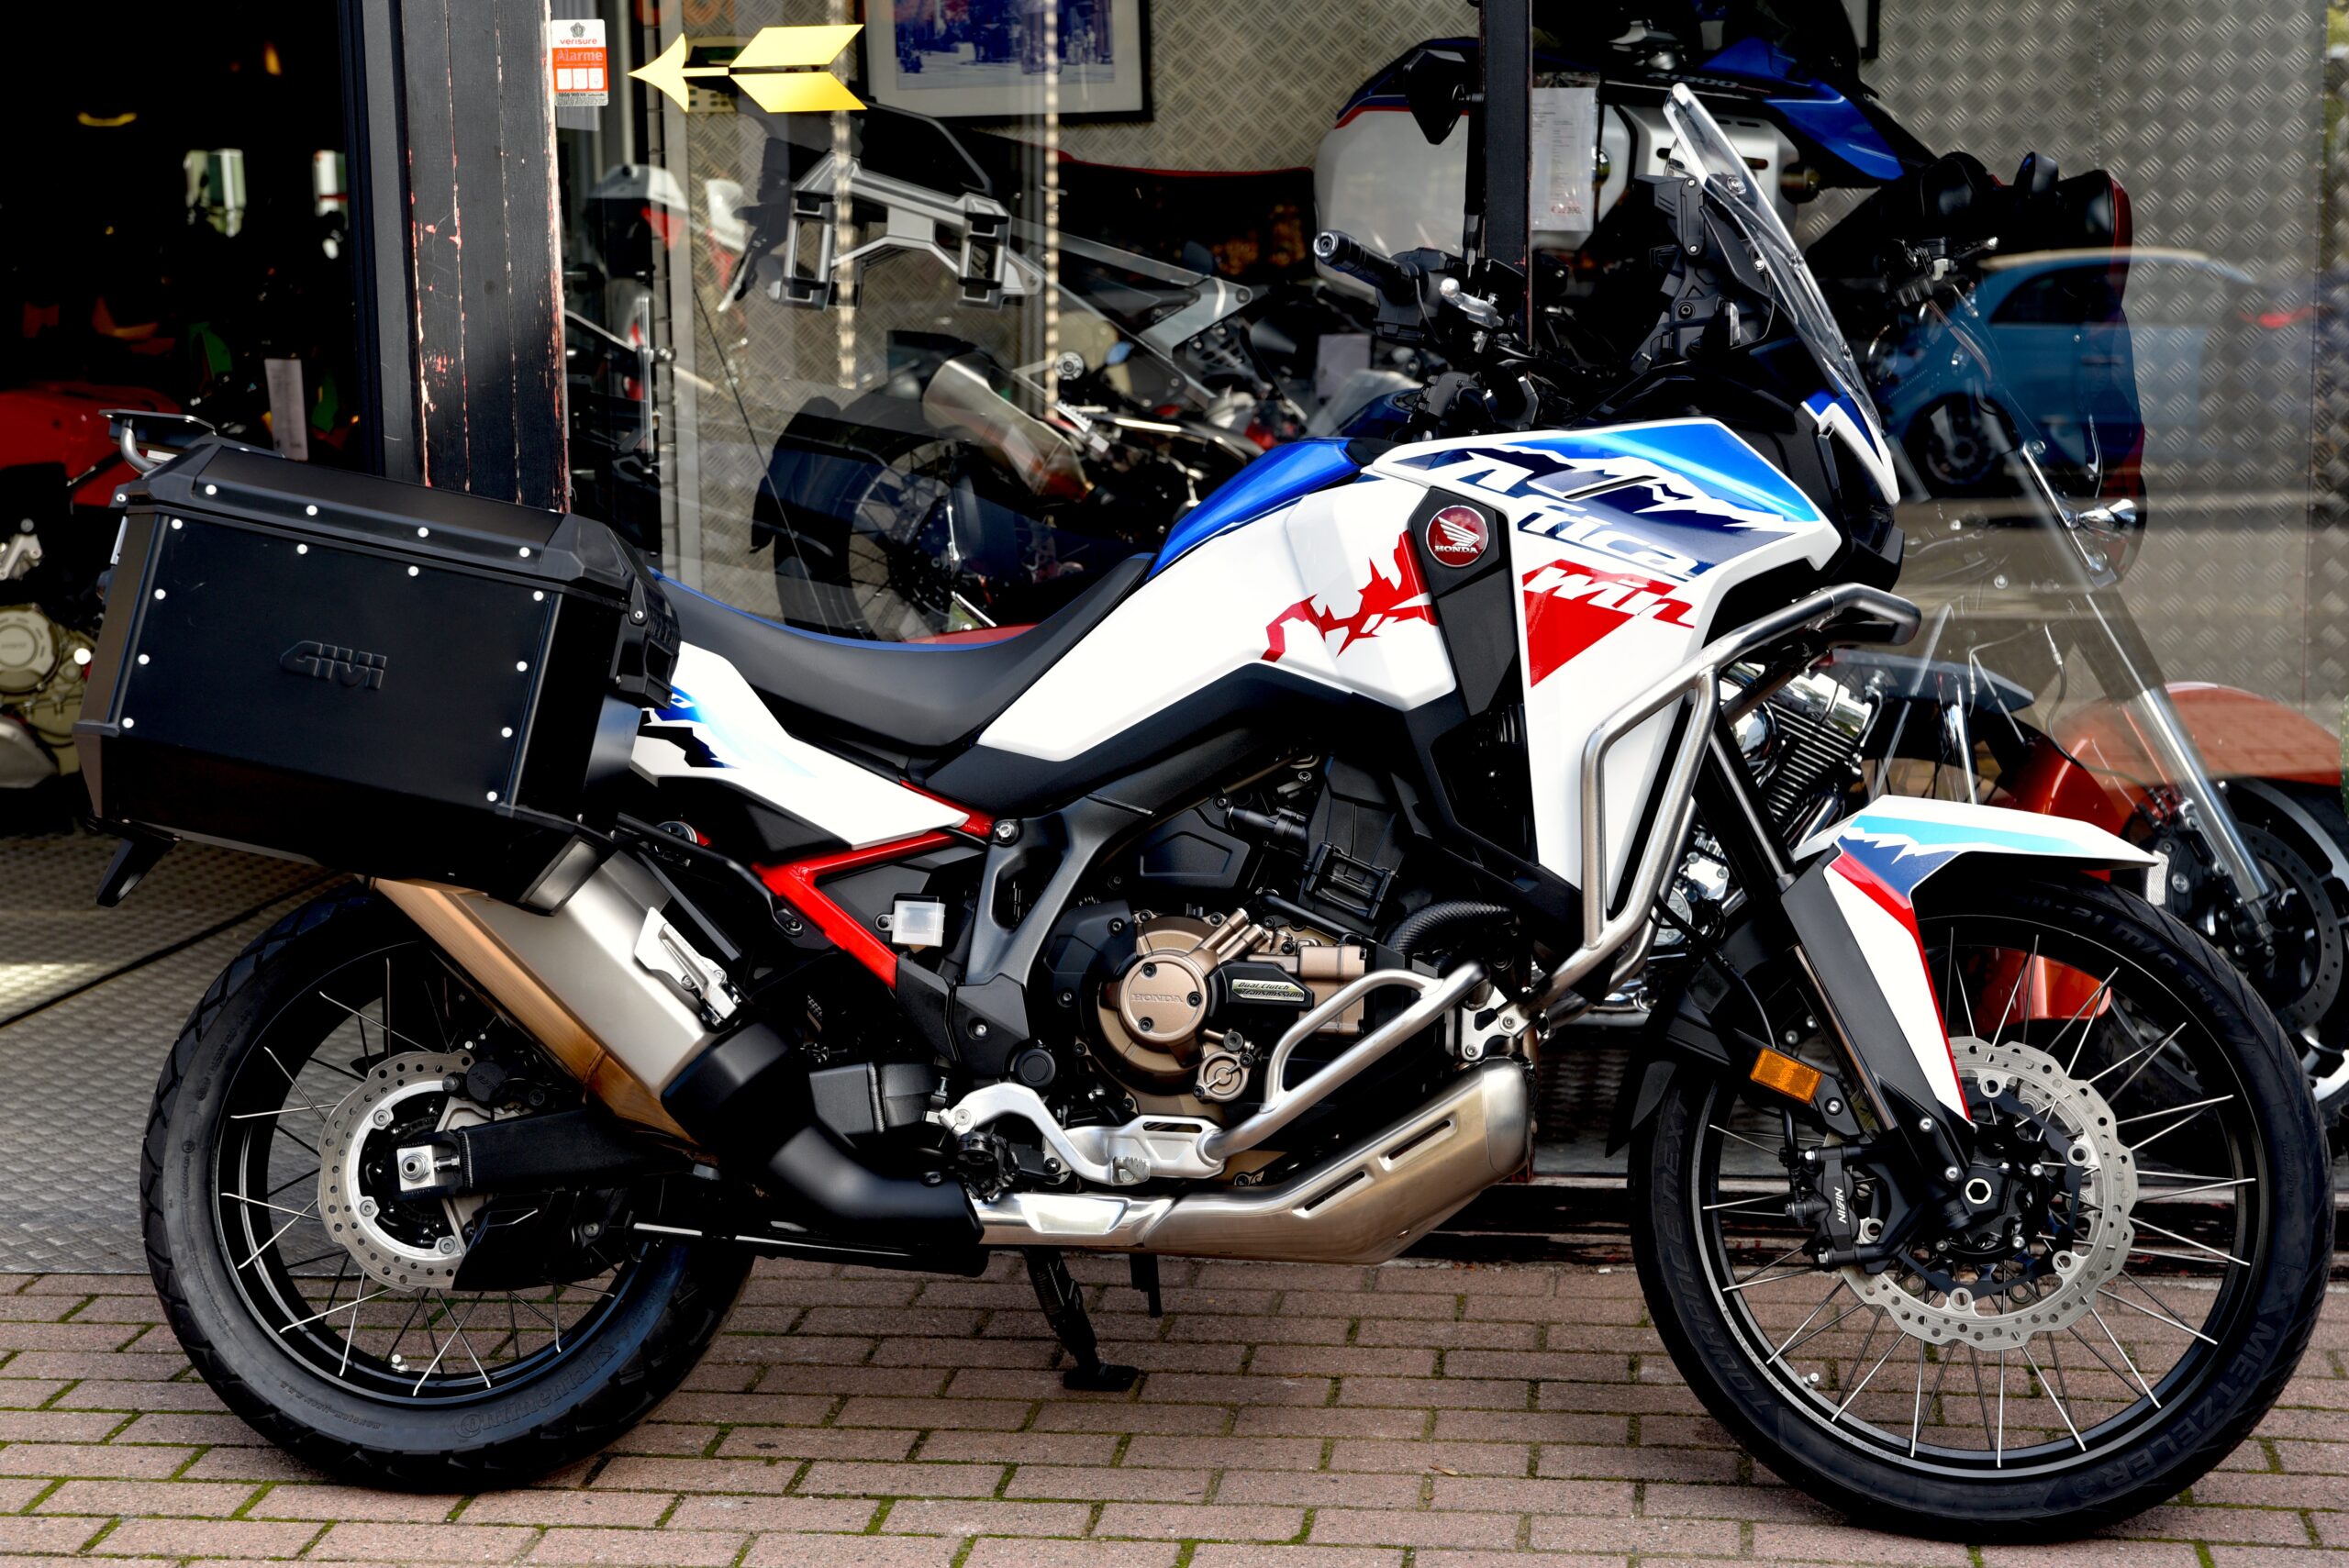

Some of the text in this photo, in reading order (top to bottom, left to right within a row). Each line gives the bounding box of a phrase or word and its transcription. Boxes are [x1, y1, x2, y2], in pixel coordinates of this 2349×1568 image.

[559, 38, 597, 46] verisure
[556, 49, 604, 61] Alarme
[1434, 544, 1478, 554] HONDA
[279, 639, 387, 690] GIVI
[1131, 992, 1184, 1003] HONDA
[1241, 988, 1304, 998] Transmission
[1833, 1186, 1847, 1224] NISSIN
[453, 1357, 602, 1439] Continental
[2104, 1320, 2277, 1487] METZELER
